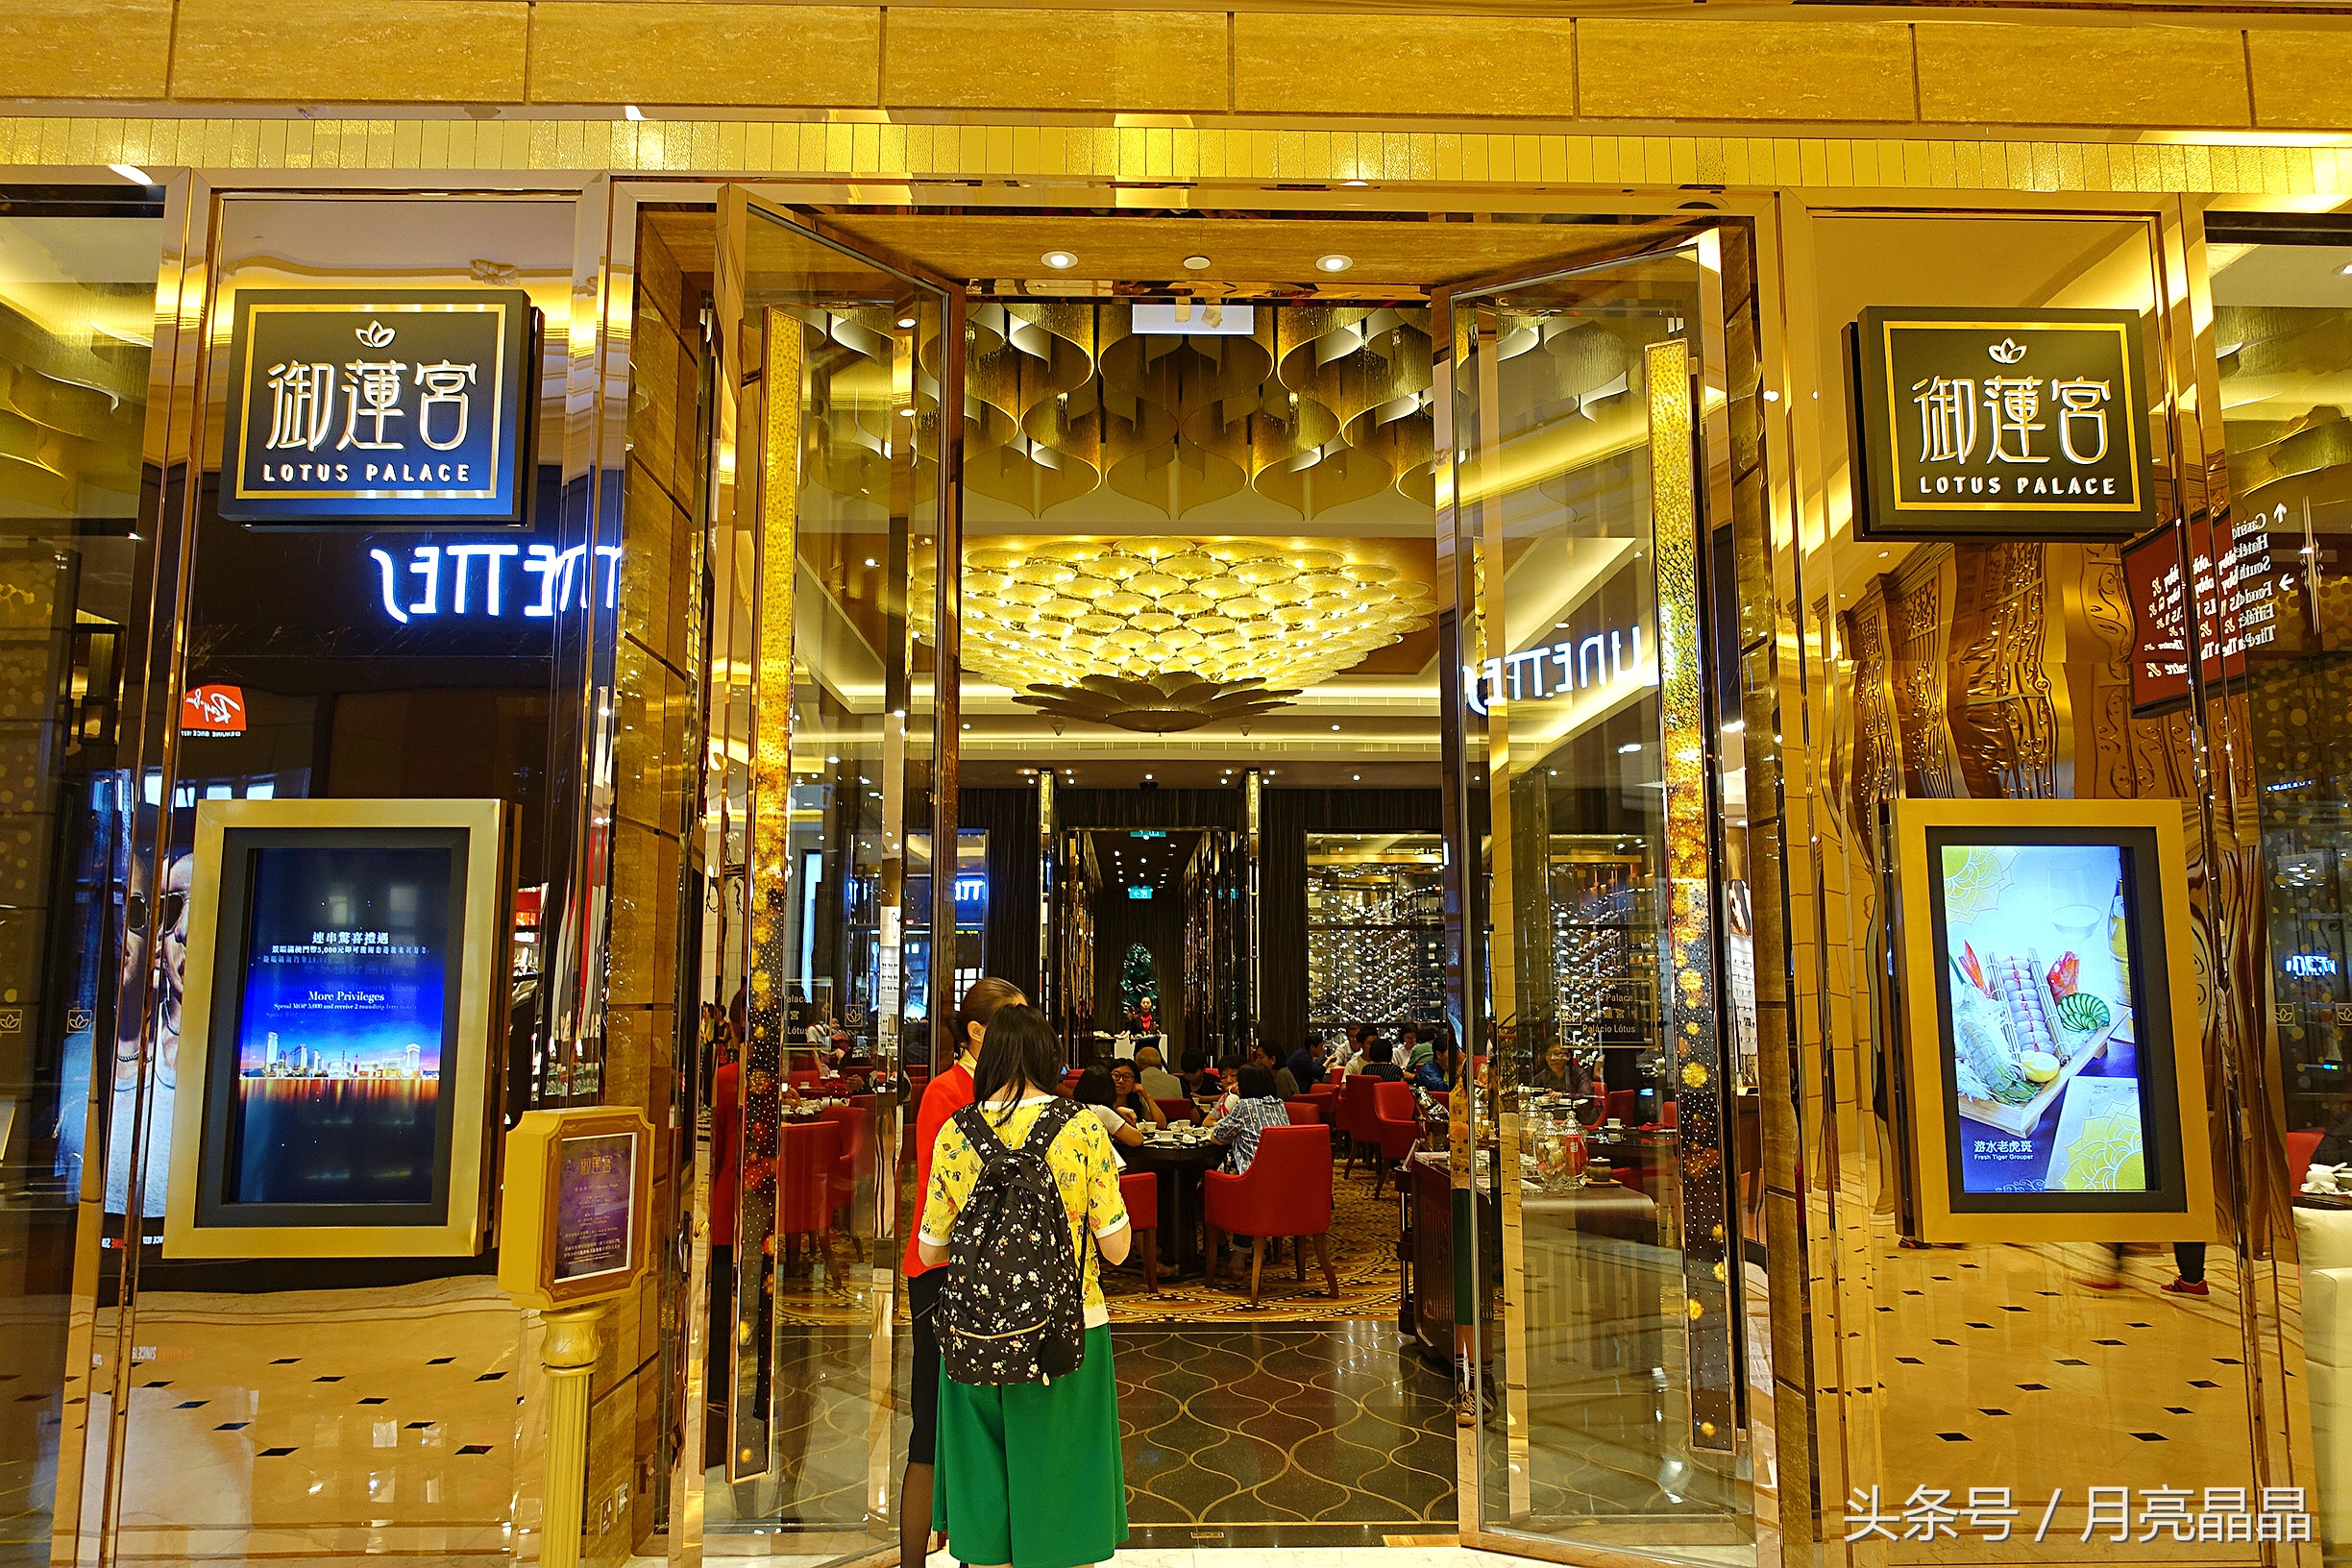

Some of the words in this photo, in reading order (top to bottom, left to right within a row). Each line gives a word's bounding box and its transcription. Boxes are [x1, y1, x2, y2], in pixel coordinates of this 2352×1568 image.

[265, 358, 478, 453] 御蓮宮
[1911, 375, 2111, 465] 御蓮宮
[263, 463, 349, 482] LOTUS
[367, 463, 470, 482] PALACE
[1920, 476, 2001, 494] LOTUS
[2018, 477, 2117, 496] PALACE
[308, 991, 334, 1001] More
[336, 991, 385, 1004] Privileges
[1973, 1139, 2033, 1153] 游水老虎斑
